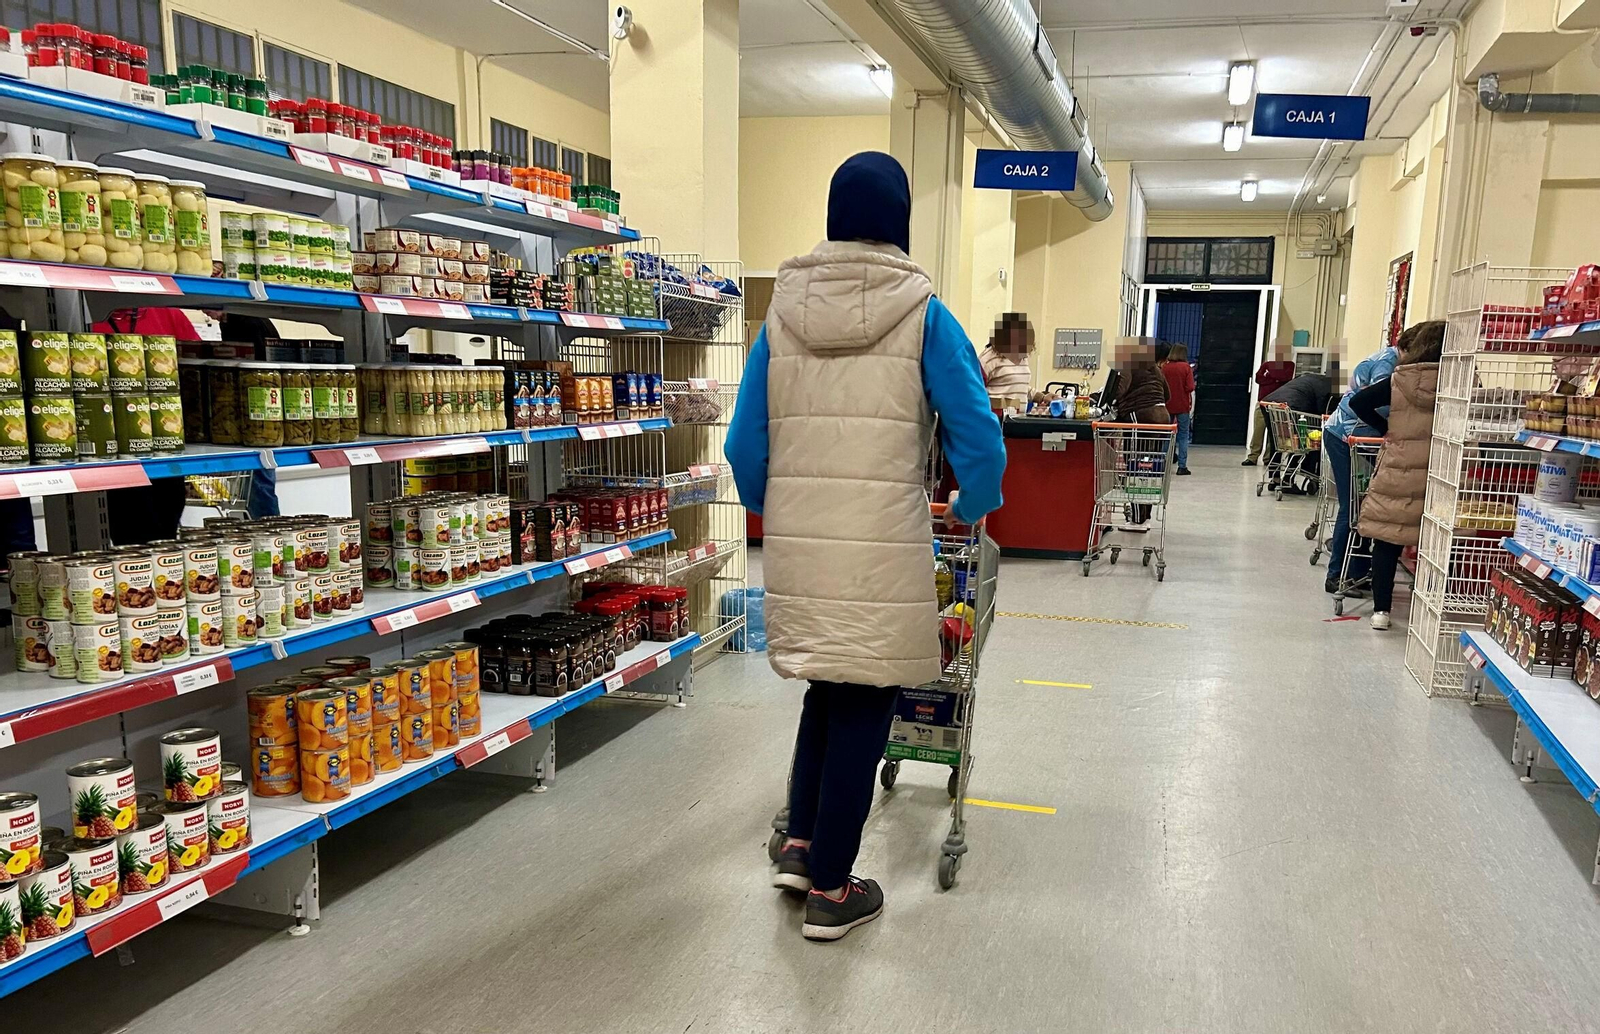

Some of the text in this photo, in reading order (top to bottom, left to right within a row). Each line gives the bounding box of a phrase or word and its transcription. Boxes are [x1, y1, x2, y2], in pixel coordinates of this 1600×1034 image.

[1286, 110, 1335, 123] CAJA 1
[1003, 164, 1049, 177] CAJA 2
[43, 338, 67, 350] eliges
[114, 340, 138, 351] eliges
[149, 341, 174, 352] eliges
[41, 404, 69, 415] eliges
[916, 749, 937, 761] CERO
[224, 801, 243, 809] NORVI
[12, 815, 34, 826] NORVI
[92, 853, 113, 864] NORVI
